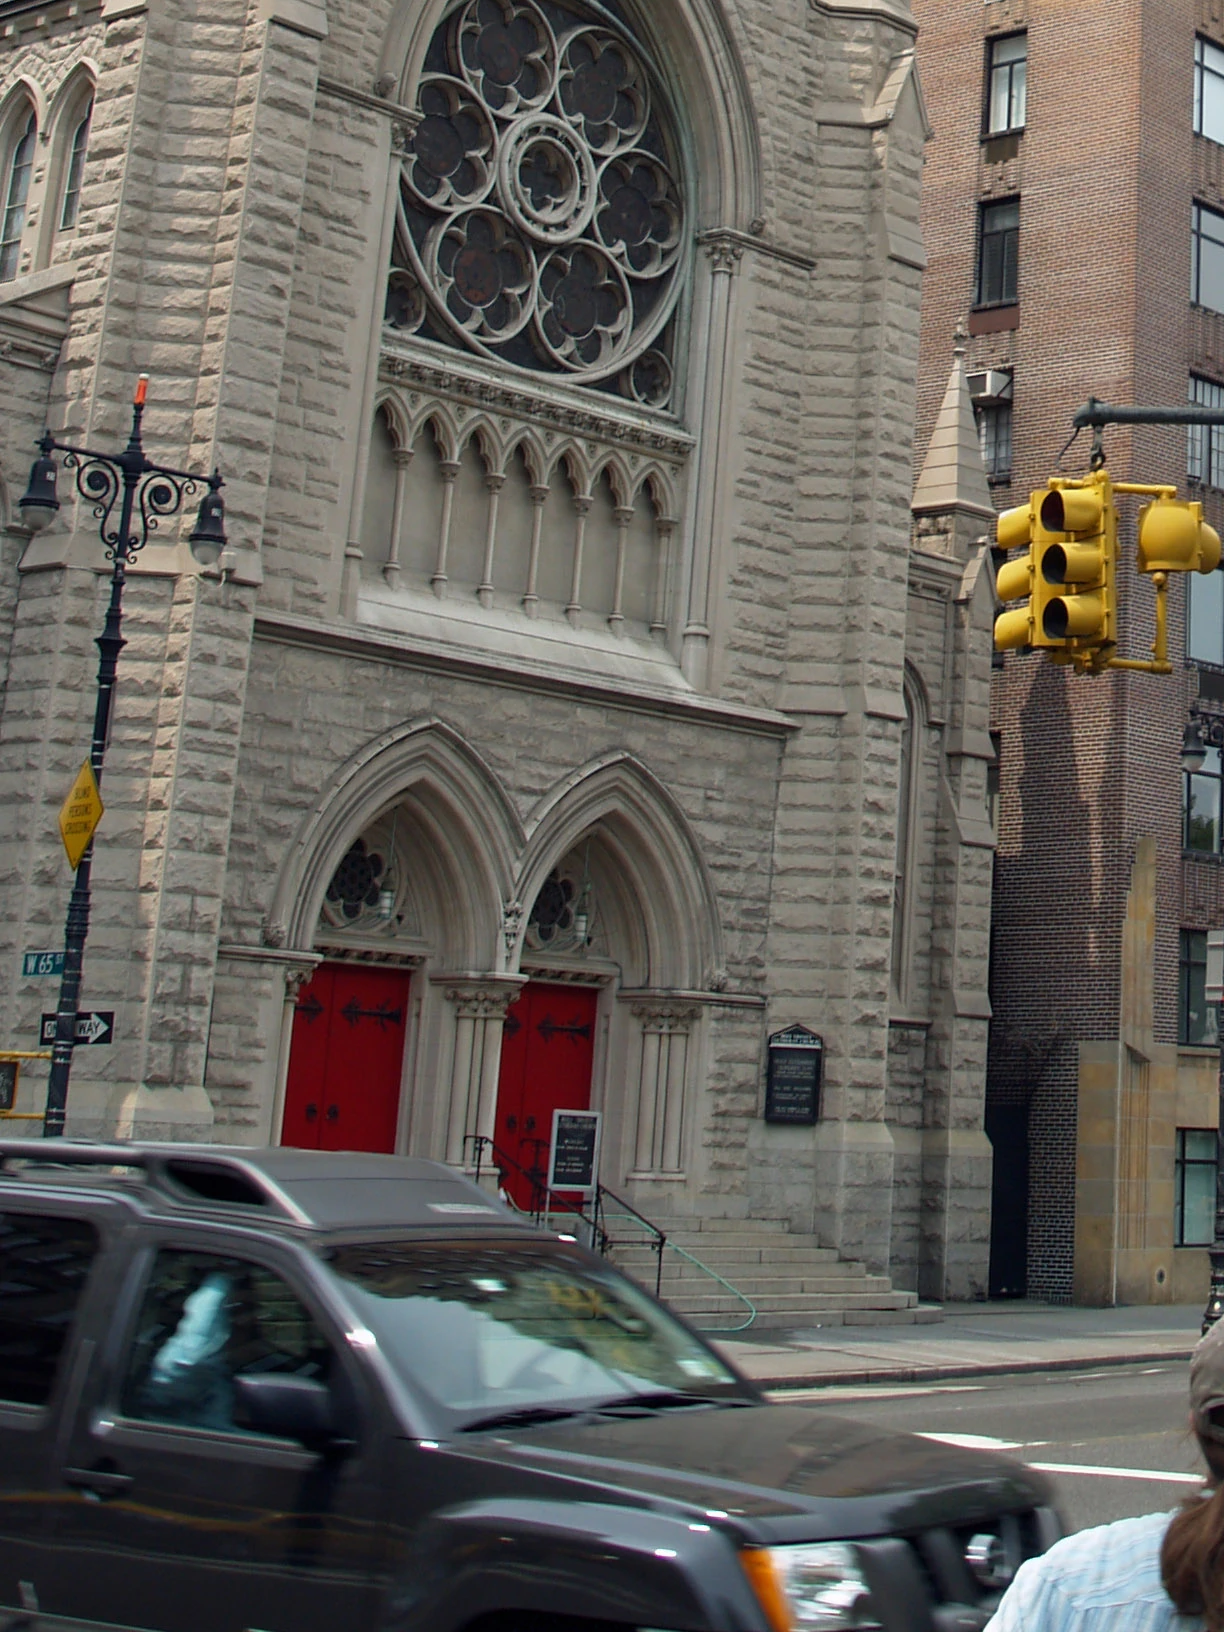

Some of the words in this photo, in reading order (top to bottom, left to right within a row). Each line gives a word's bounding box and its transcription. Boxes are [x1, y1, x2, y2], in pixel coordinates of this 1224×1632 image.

[26, 955, 37, 974] W
[39, 954, 54, 974] 65
[79, 1021, 101, 1036] WAY
